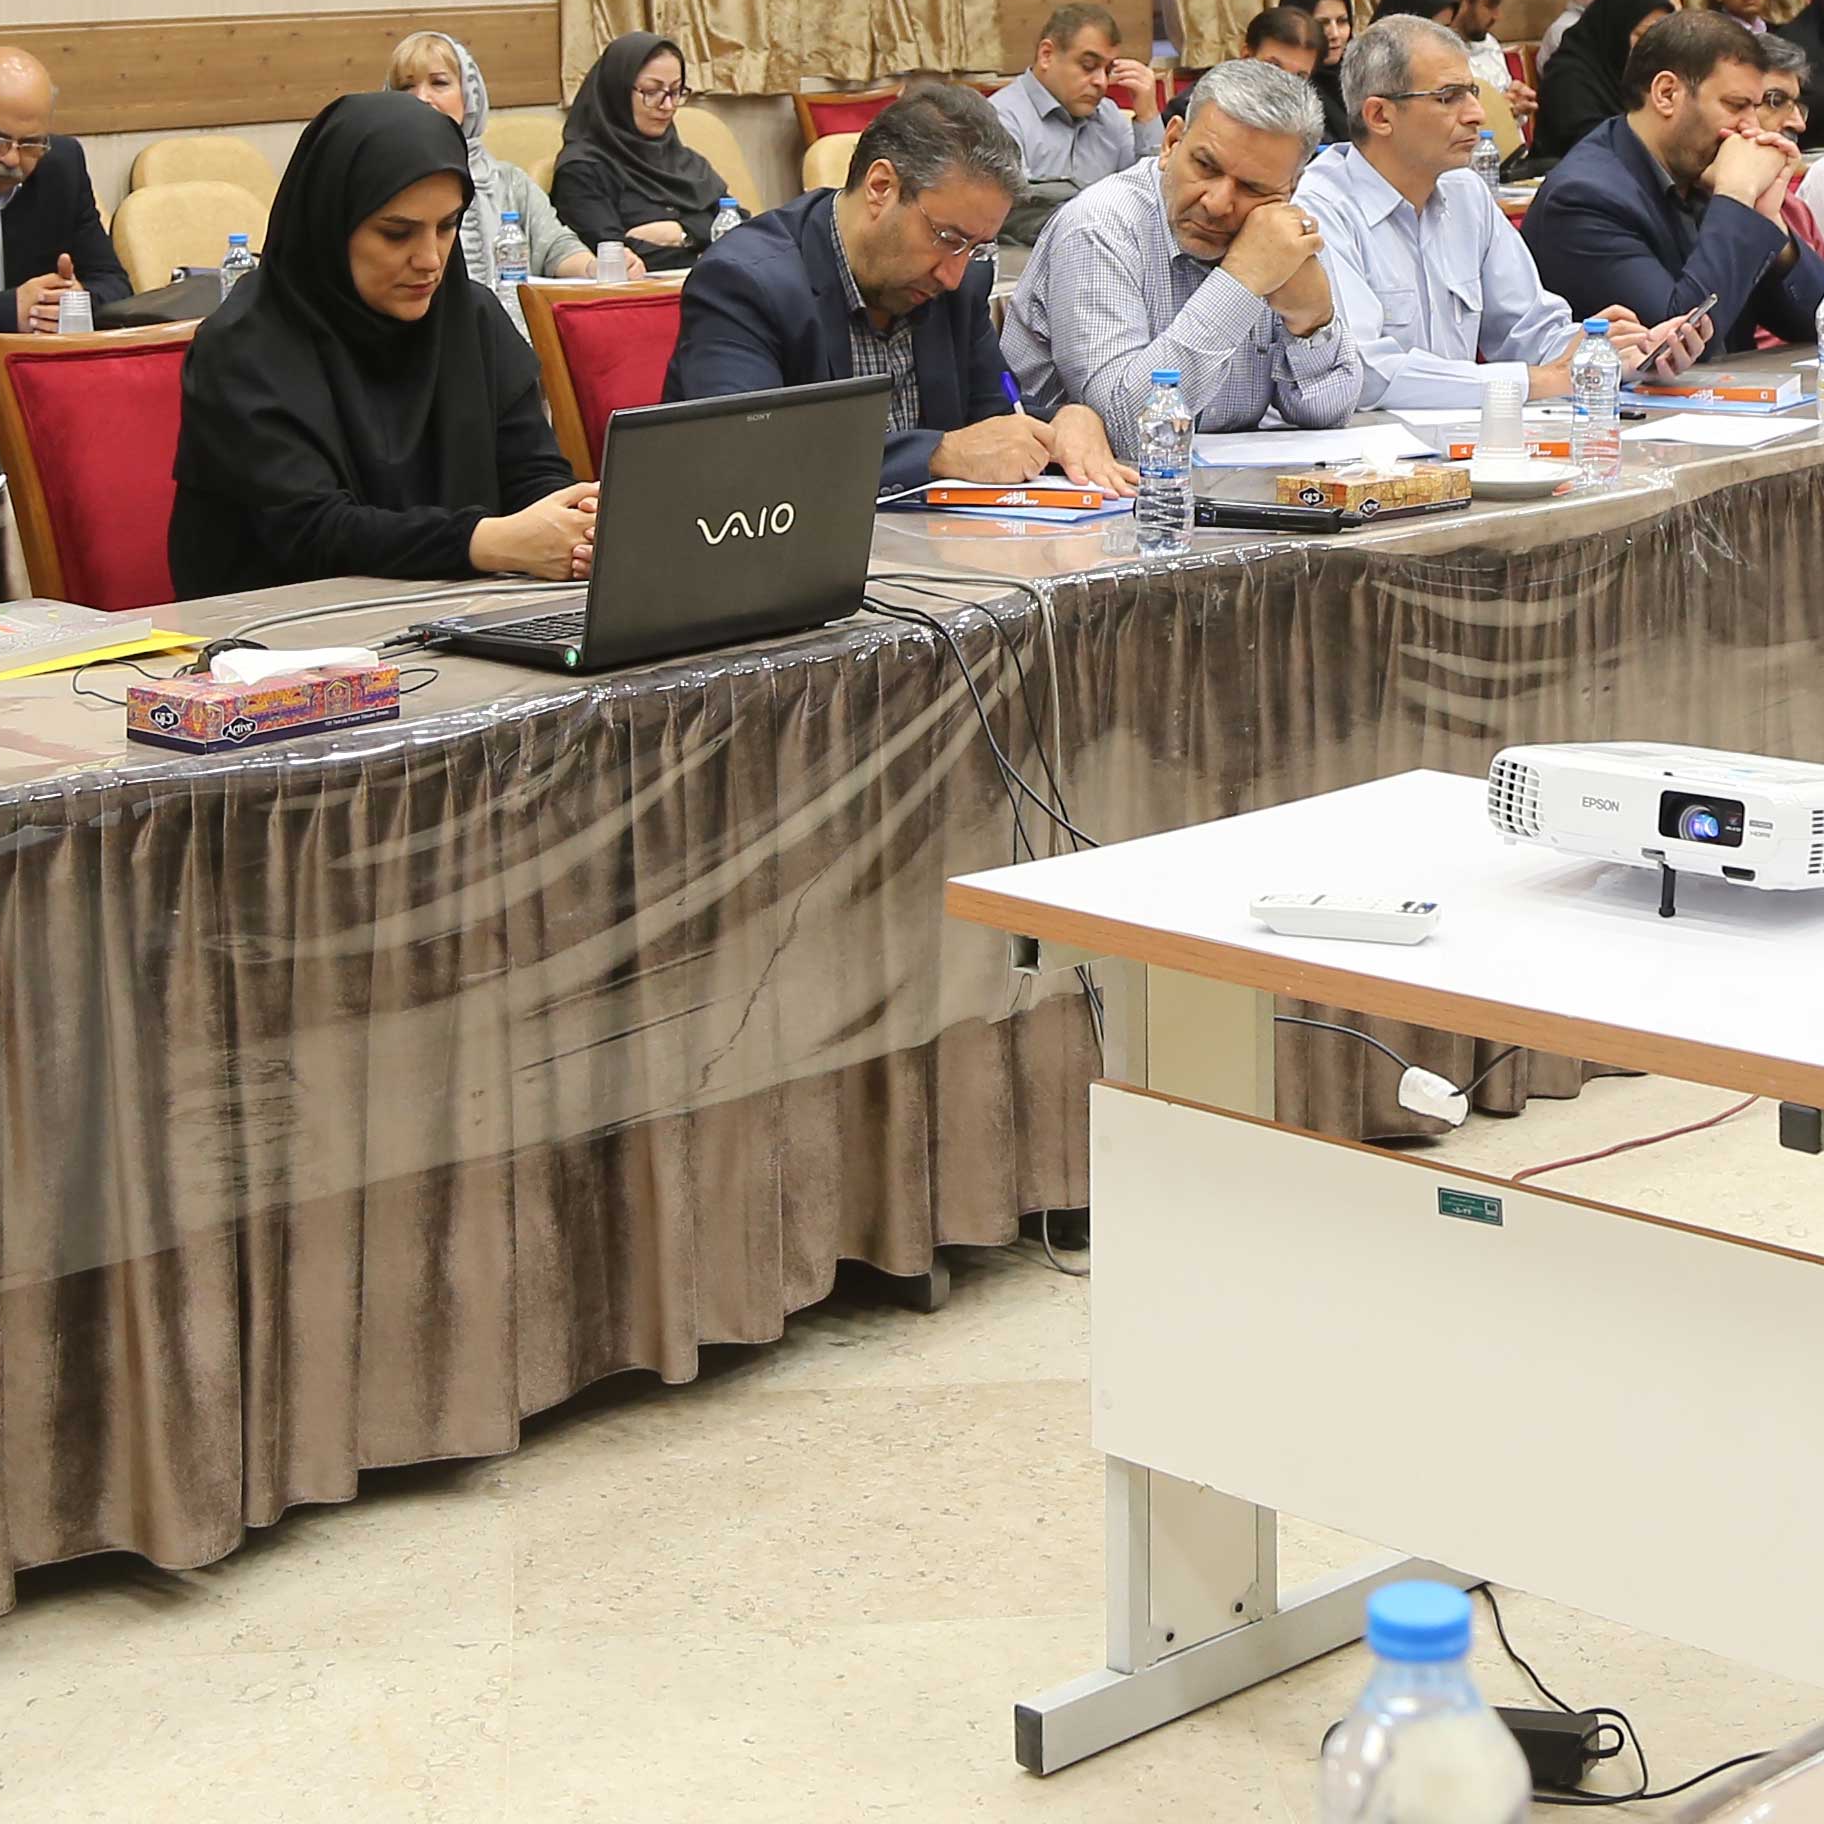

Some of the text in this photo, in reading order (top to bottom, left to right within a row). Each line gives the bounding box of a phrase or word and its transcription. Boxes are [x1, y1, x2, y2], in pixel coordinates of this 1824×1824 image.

[746, 412, 772, 422] SONY
[696, 502, 796, 545] VAIO
[1582, 795, 1620, 812] EPSON
